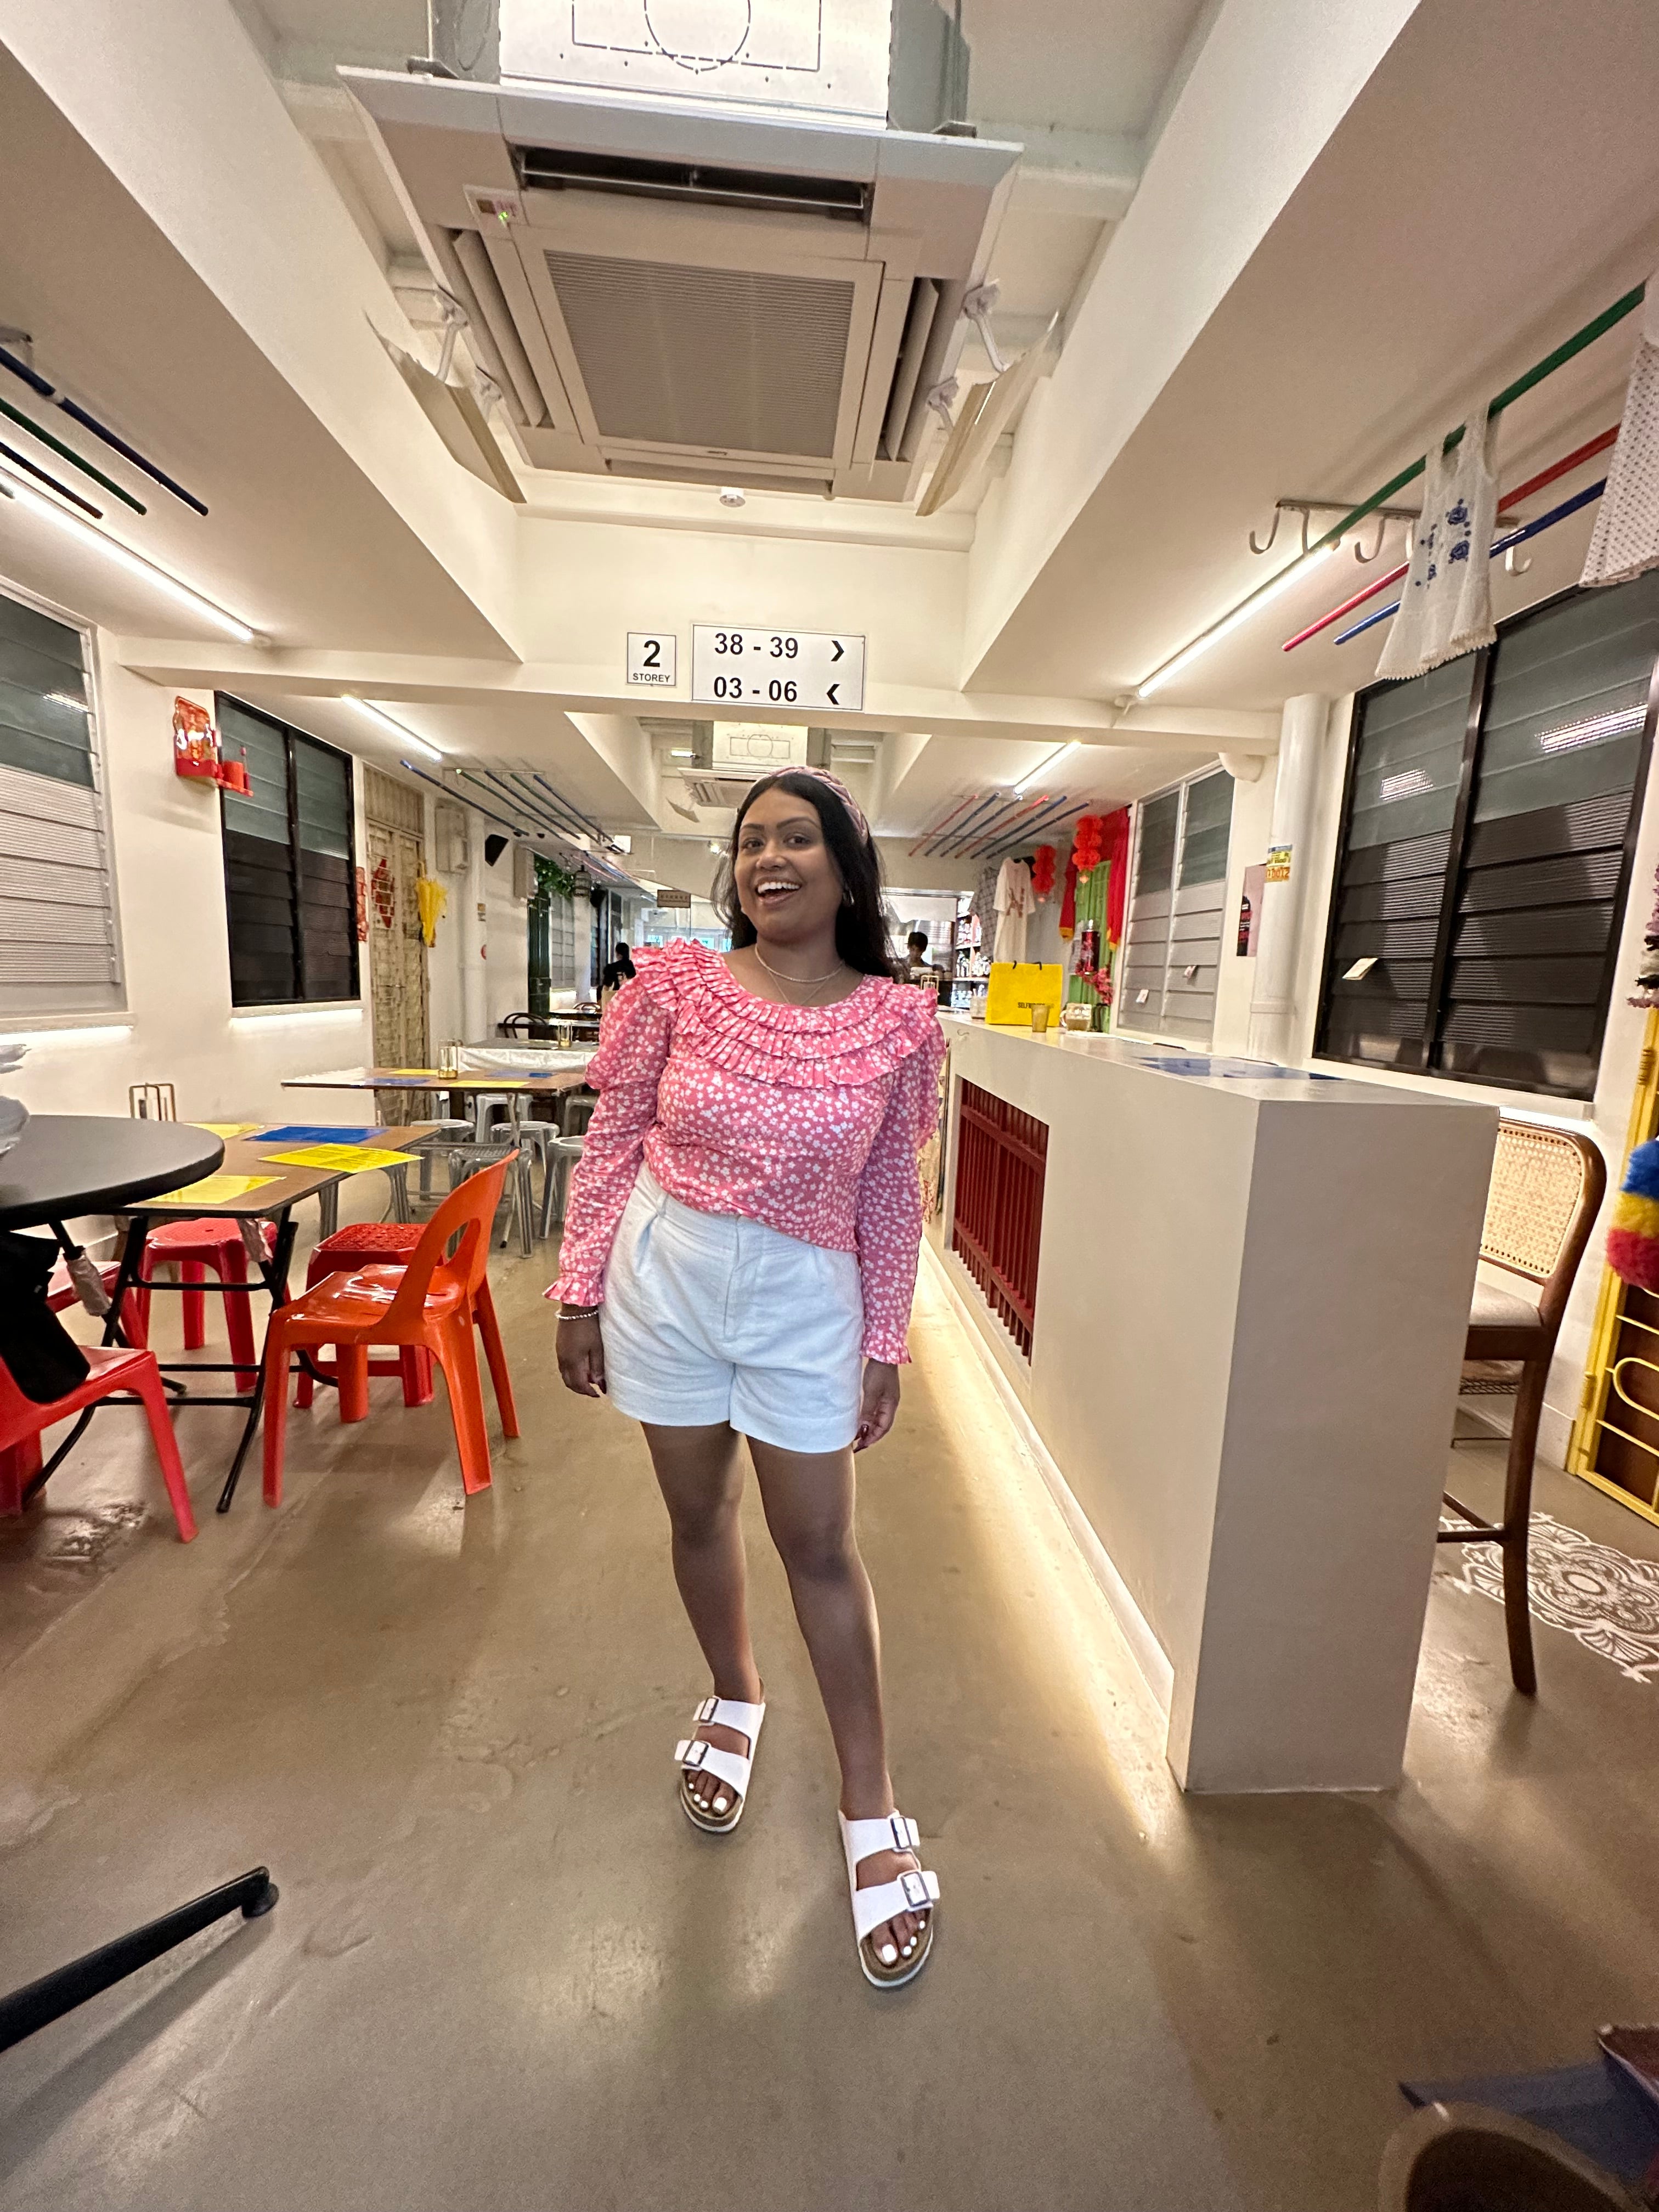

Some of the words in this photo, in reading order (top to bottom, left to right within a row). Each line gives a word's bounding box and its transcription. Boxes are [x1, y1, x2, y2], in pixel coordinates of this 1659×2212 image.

[643, 640, 661, 668] 2
[714, 633, 743, 655] 38
[770, 636, 799, 659] 39
[633, 673, 670, 683] STOREY
[714, 676, 743, 699] 03
[769, 680, 798, 702] 06
